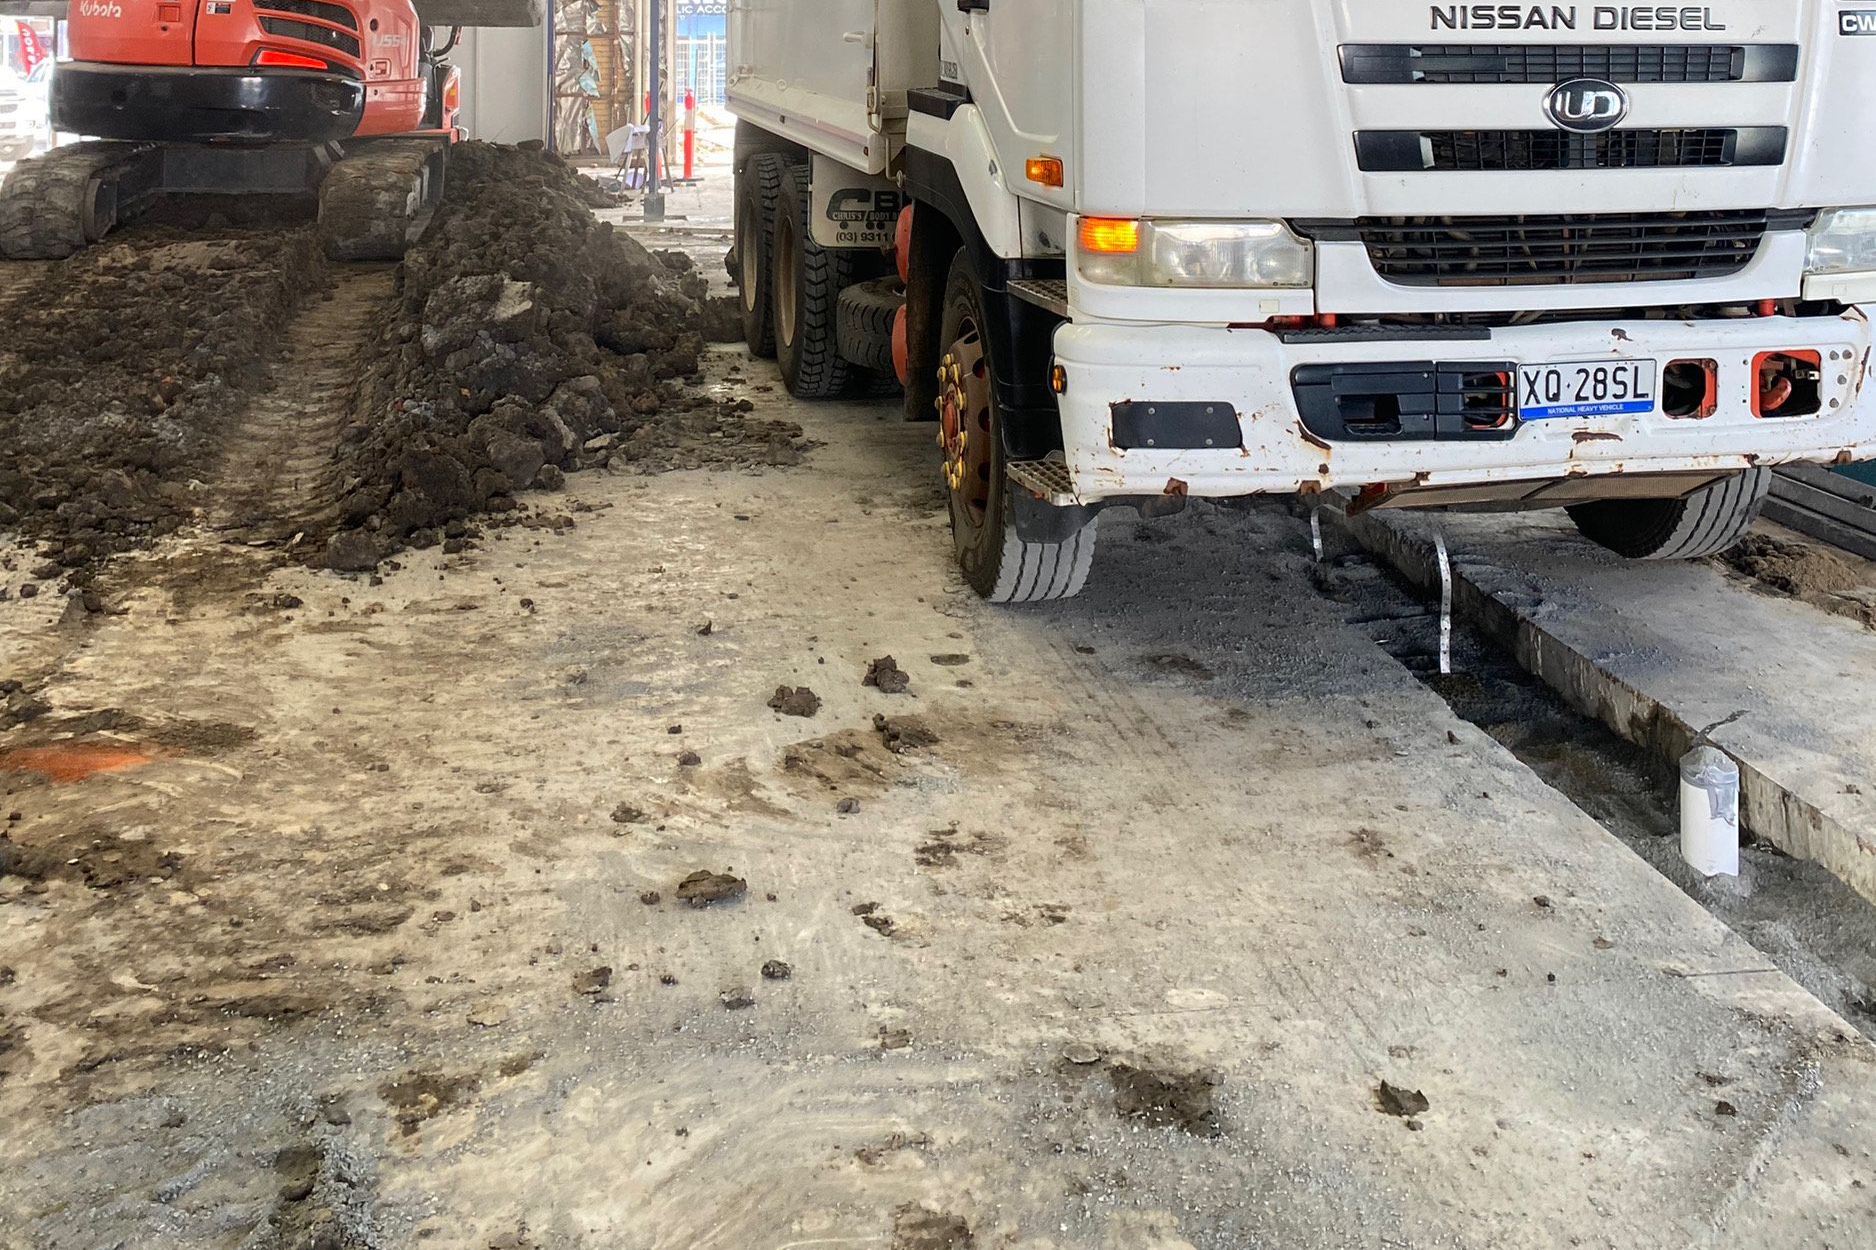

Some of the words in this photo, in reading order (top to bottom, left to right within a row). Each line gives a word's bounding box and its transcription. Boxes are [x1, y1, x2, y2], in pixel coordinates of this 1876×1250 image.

[80, 0, 122, 18] Kubota
[1430, 5, 1576, 30] NISSAN
[1593, 6, 1726, 31] DIESEL
[1555, 90, 1621, 122] UD
[832, 212, 862, 221] CHRIS'S
[869, 212, 889, 221] BODY
[836, 232, 857, 243] (03)
[860, 232, 889, 242] 9311
[1547, 406, 1577, 415] NATIONAL
[1599, 403, 1624, 411] VEHICLE
